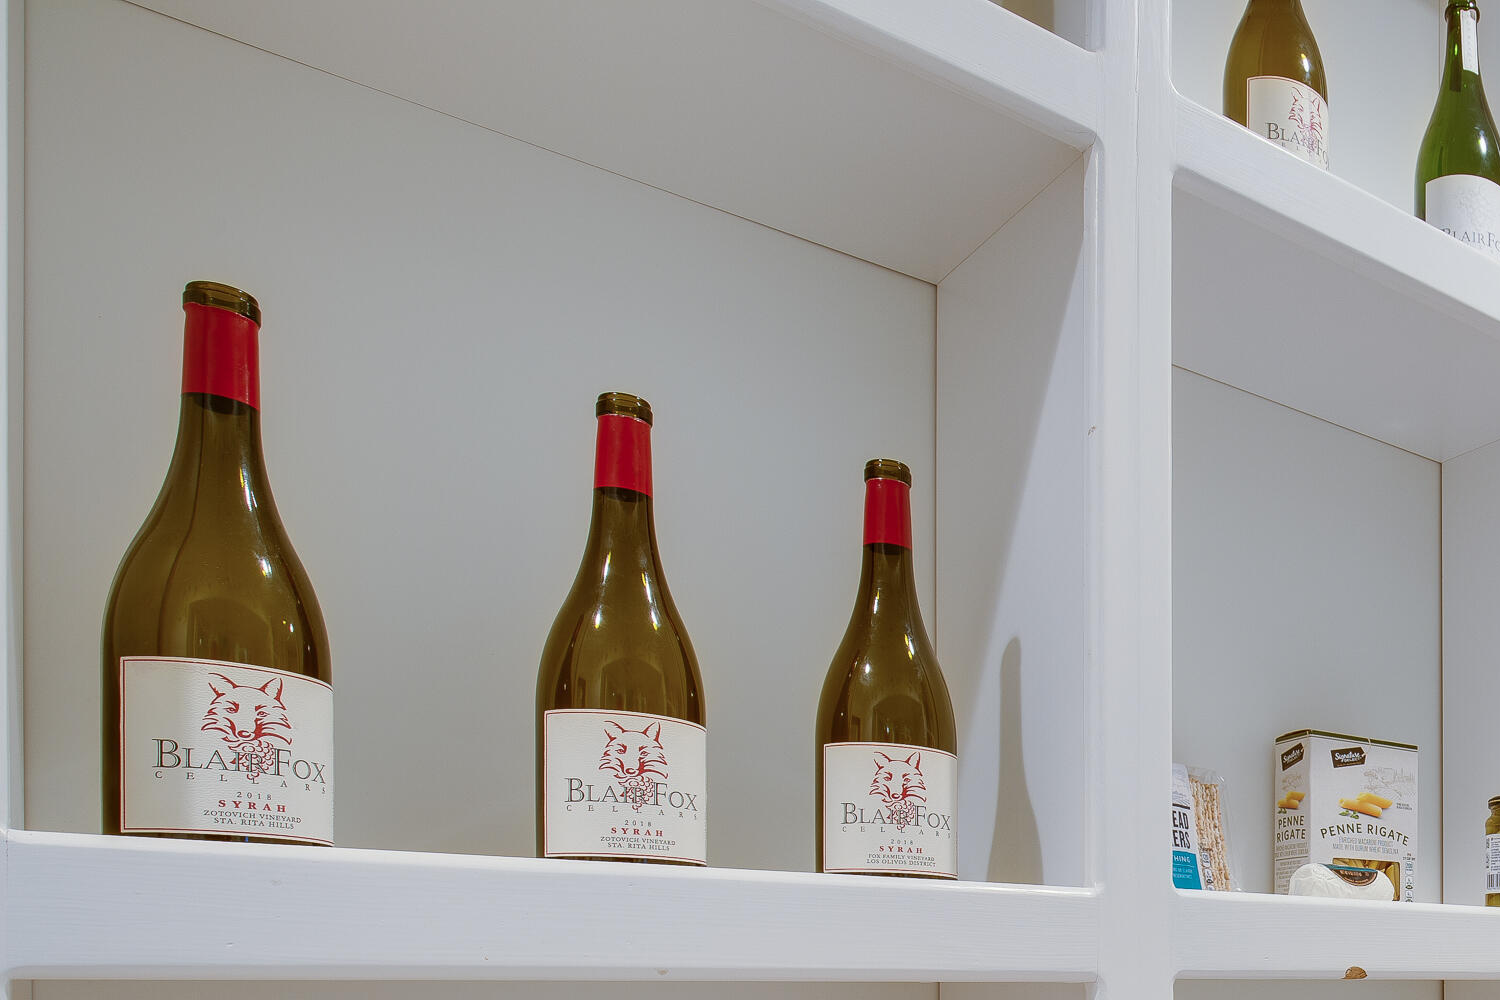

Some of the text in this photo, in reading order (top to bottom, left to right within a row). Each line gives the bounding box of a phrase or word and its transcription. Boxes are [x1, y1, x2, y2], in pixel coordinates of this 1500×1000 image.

[152, 738, 326, 785] BLAIR FOX
[154, 770, 327, 795] CELLARS
[236, 791, 272, 801] 2018
[649, 781, 699, 812] FOX
[218, 799, 287, 813] SYRAH
[203, 809, 302, 824] ZOTOVICH VINEYARD
[213, 816, 295, 830] STA. RITA HILLS
[912, 805, 951, 832] FOX
[1278, 815, 1305, 830] PENNE
[610, 827, 664, 837] SYRAH
[1172, 829, 1191, 849] ERS
[1276, 828, 1306, 844] RIGATE
[1320, 823, 1409, 846] PENNE RIGATE
[627, 842, 646, 850] RITA
[879, 845, 924, 854] SYRAH
